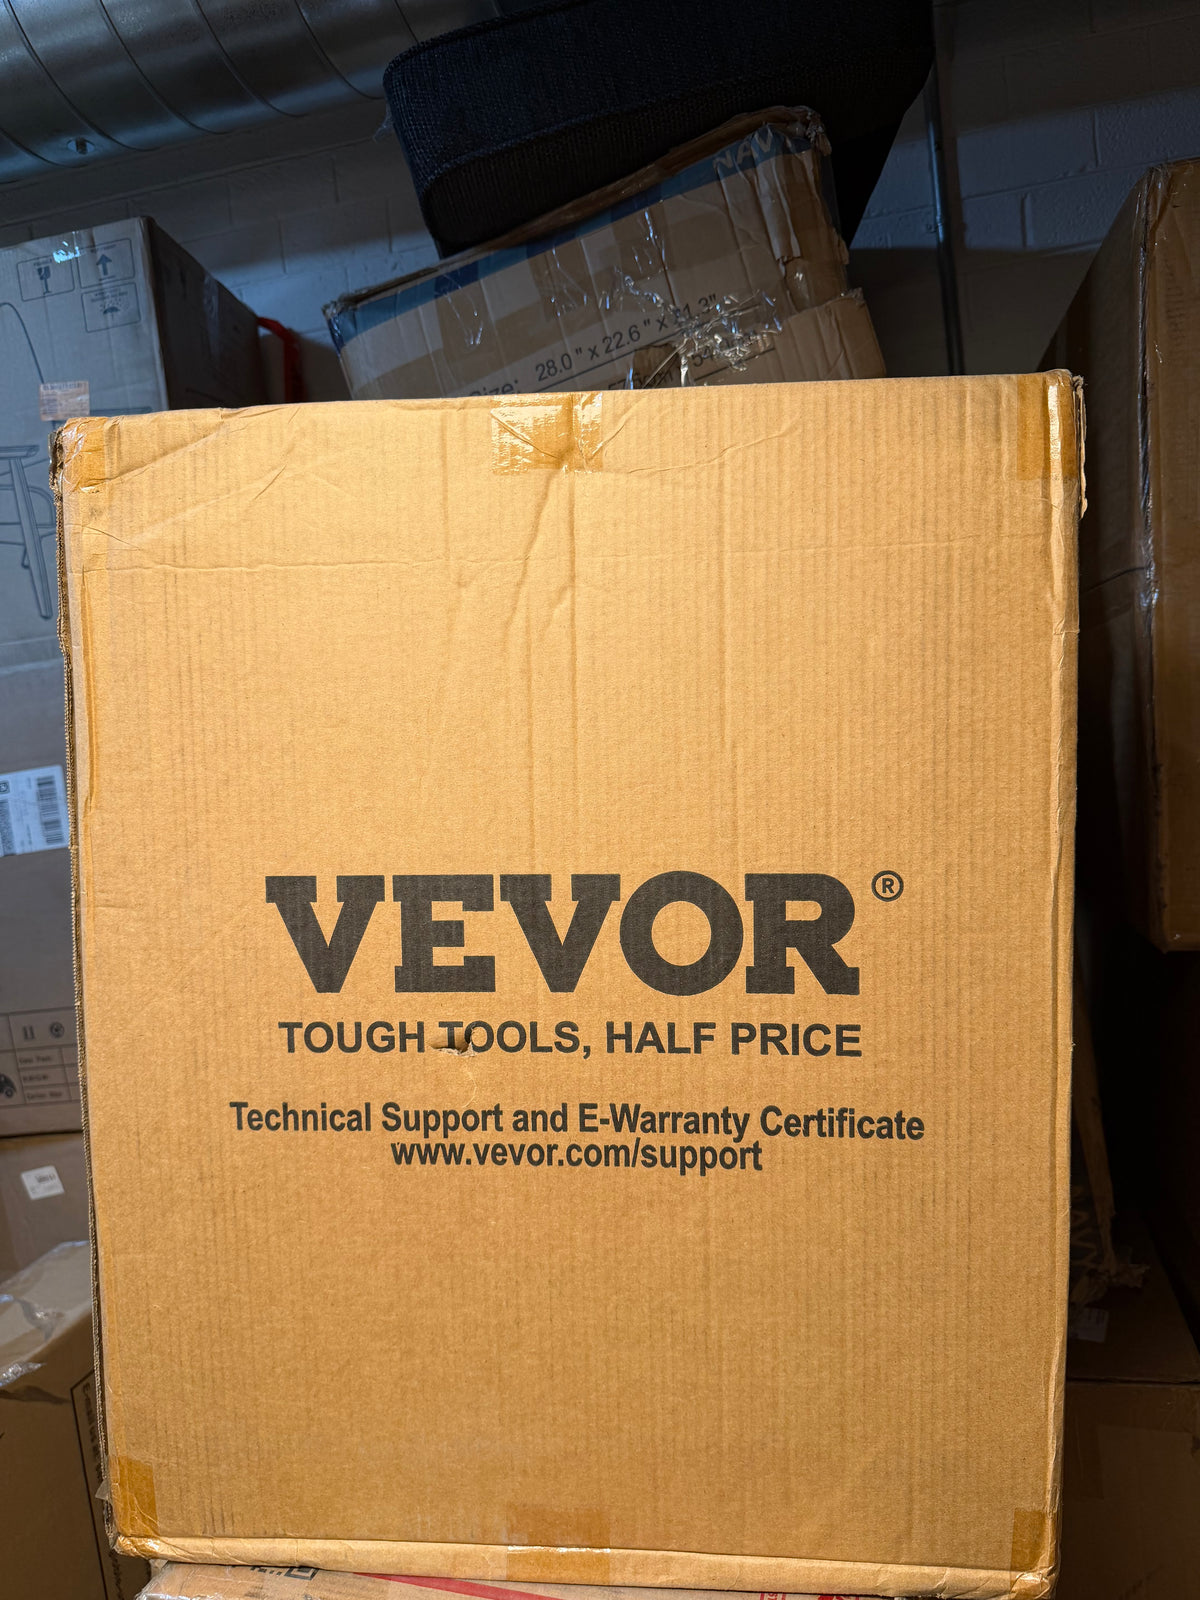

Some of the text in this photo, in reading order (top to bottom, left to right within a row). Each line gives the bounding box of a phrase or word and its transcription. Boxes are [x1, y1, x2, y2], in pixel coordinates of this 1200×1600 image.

[266, 871, 859, 995] VEVOR
[279, 1020, 862, 1060] TOUGH TOOLS, HALF PRICE
[230, 1101, 925, 1142] Technical Support and E-Warranty Certificate
[391, 1138, 763, 1176] www.vevor.com/support
